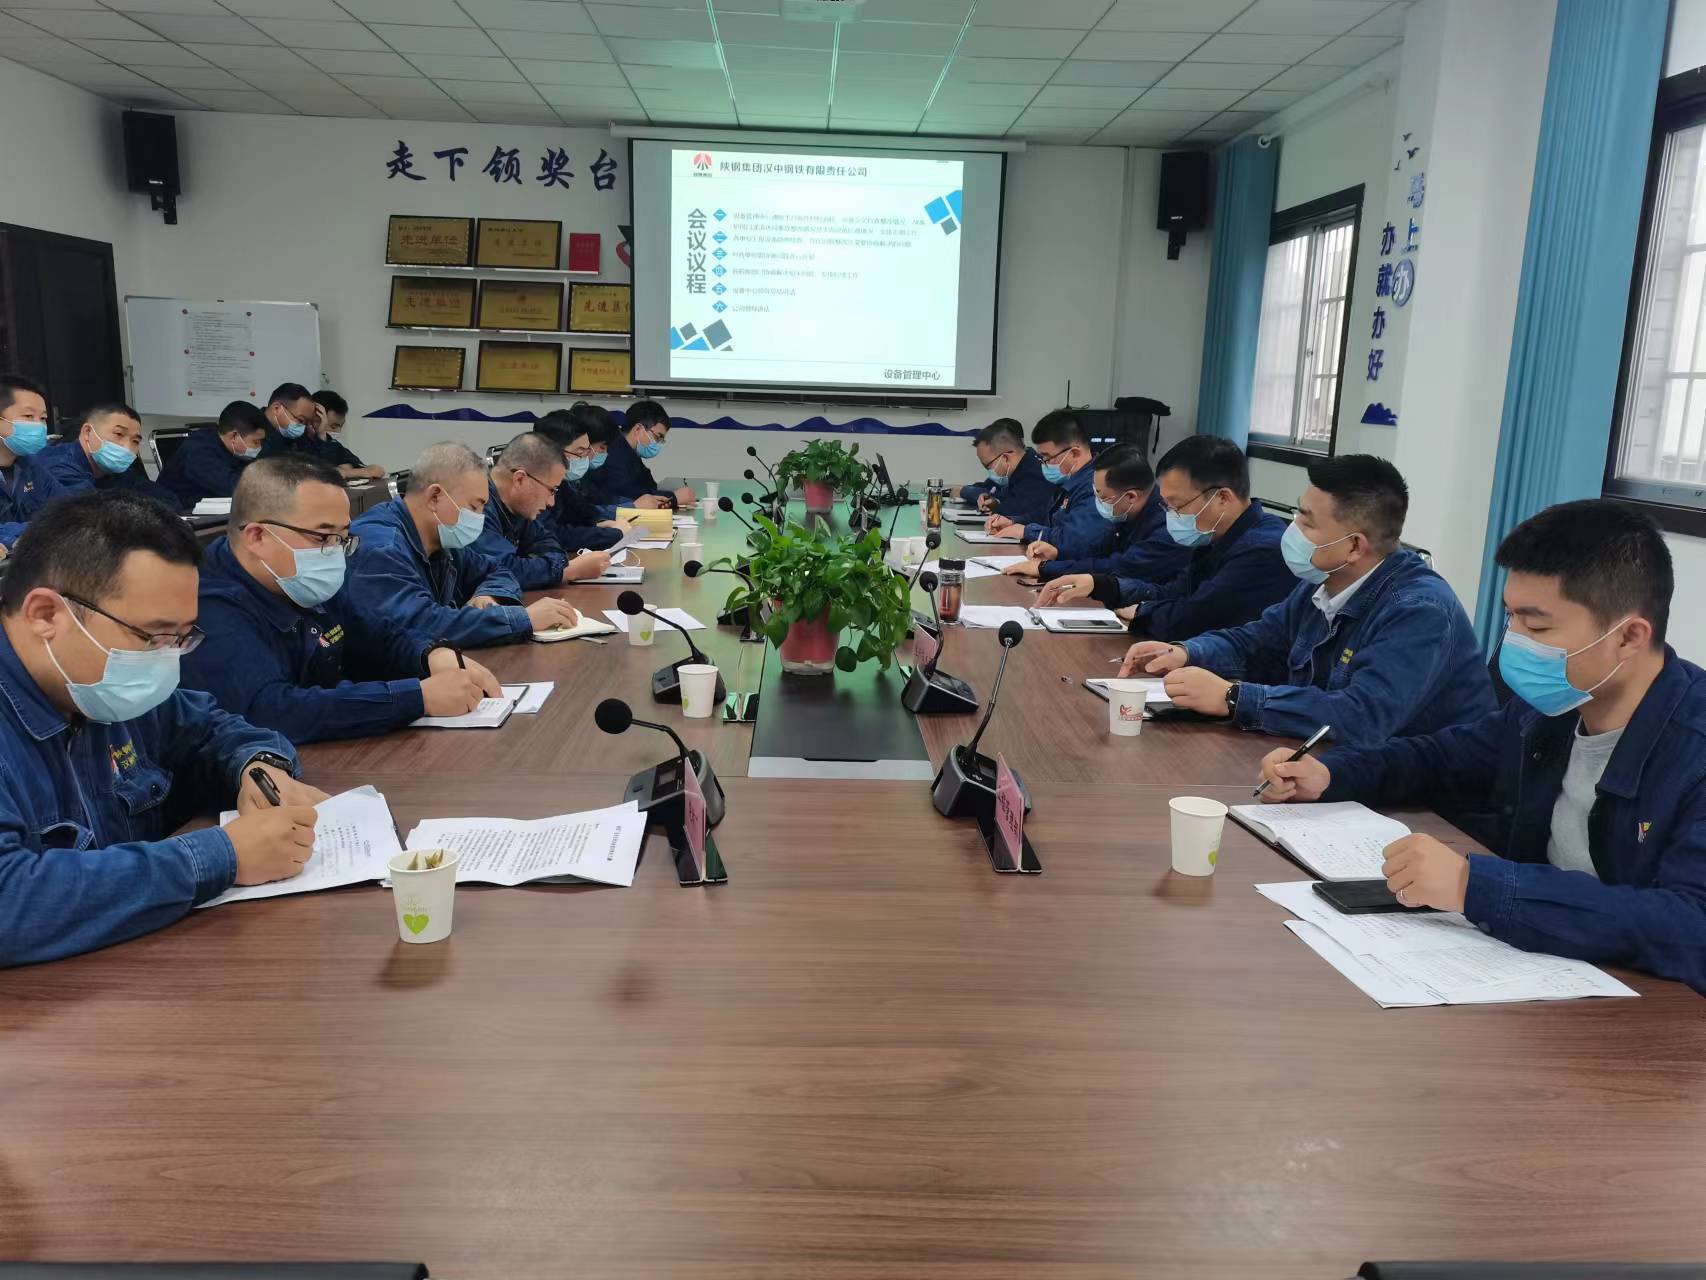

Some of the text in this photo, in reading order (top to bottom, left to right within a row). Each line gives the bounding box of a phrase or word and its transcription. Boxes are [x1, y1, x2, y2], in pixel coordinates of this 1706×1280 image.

[386, 140, 618, 191] 走下领奖台
[719, 161, 868, 177] 陕钢集团汉中钢铁有限责任公司
[686, 208, 707, 294] 会议议程
[1367, 220, 1396, 381] 办就办好
[883, 368, 941, 381] 设备管理中心
